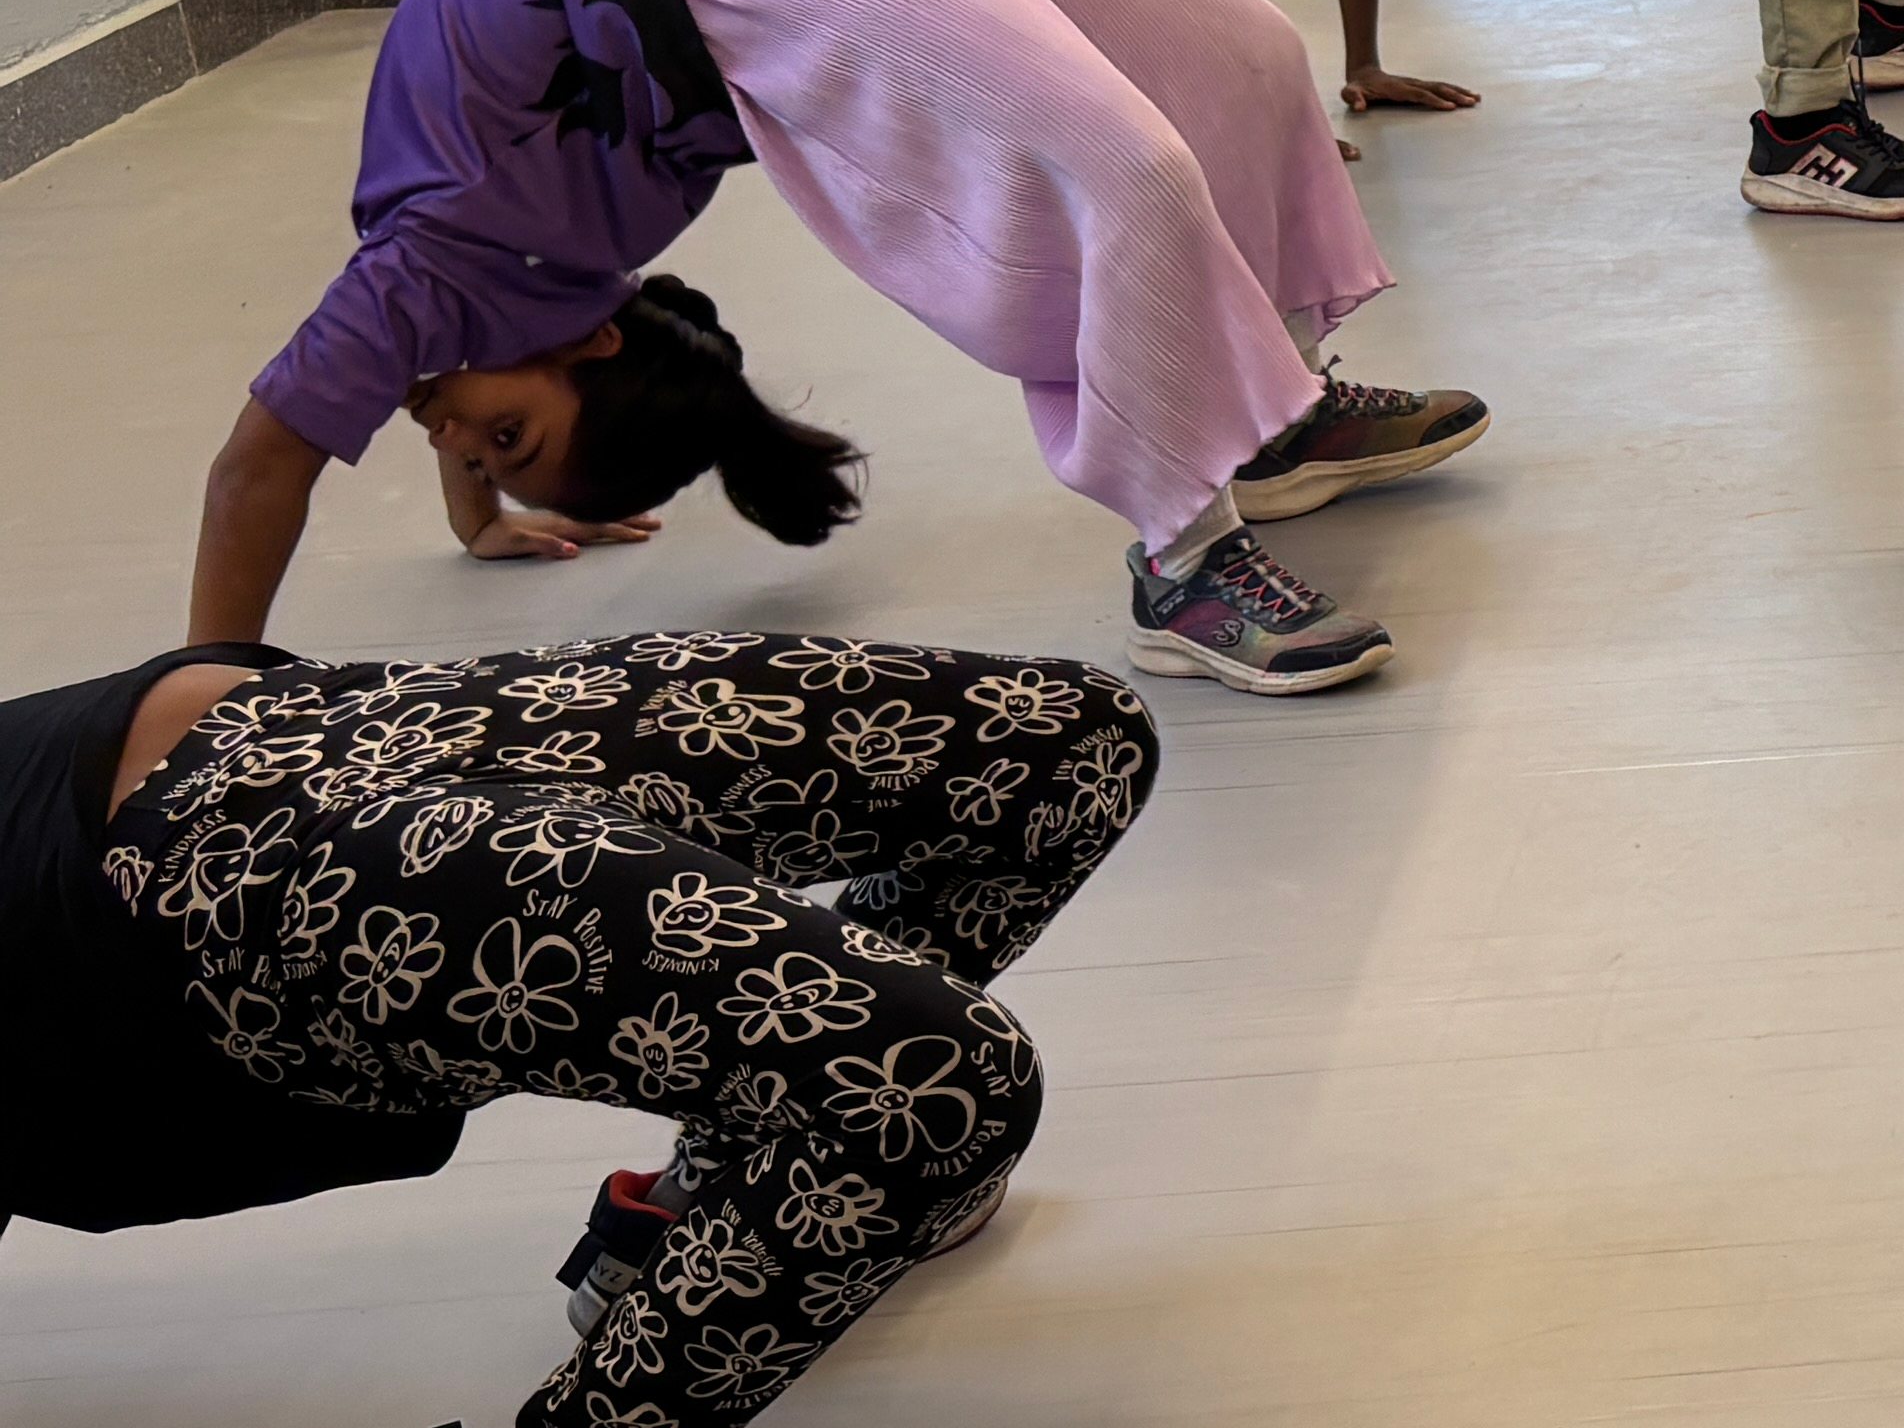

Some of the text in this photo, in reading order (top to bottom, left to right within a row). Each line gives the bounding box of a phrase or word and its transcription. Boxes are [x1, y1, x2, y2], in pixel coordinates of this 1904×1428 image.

[158, 808, 228, 883] KINDNESS
[522, 888, 578, 920] STAY
[971, 1041, 1013, 1099] STAY
